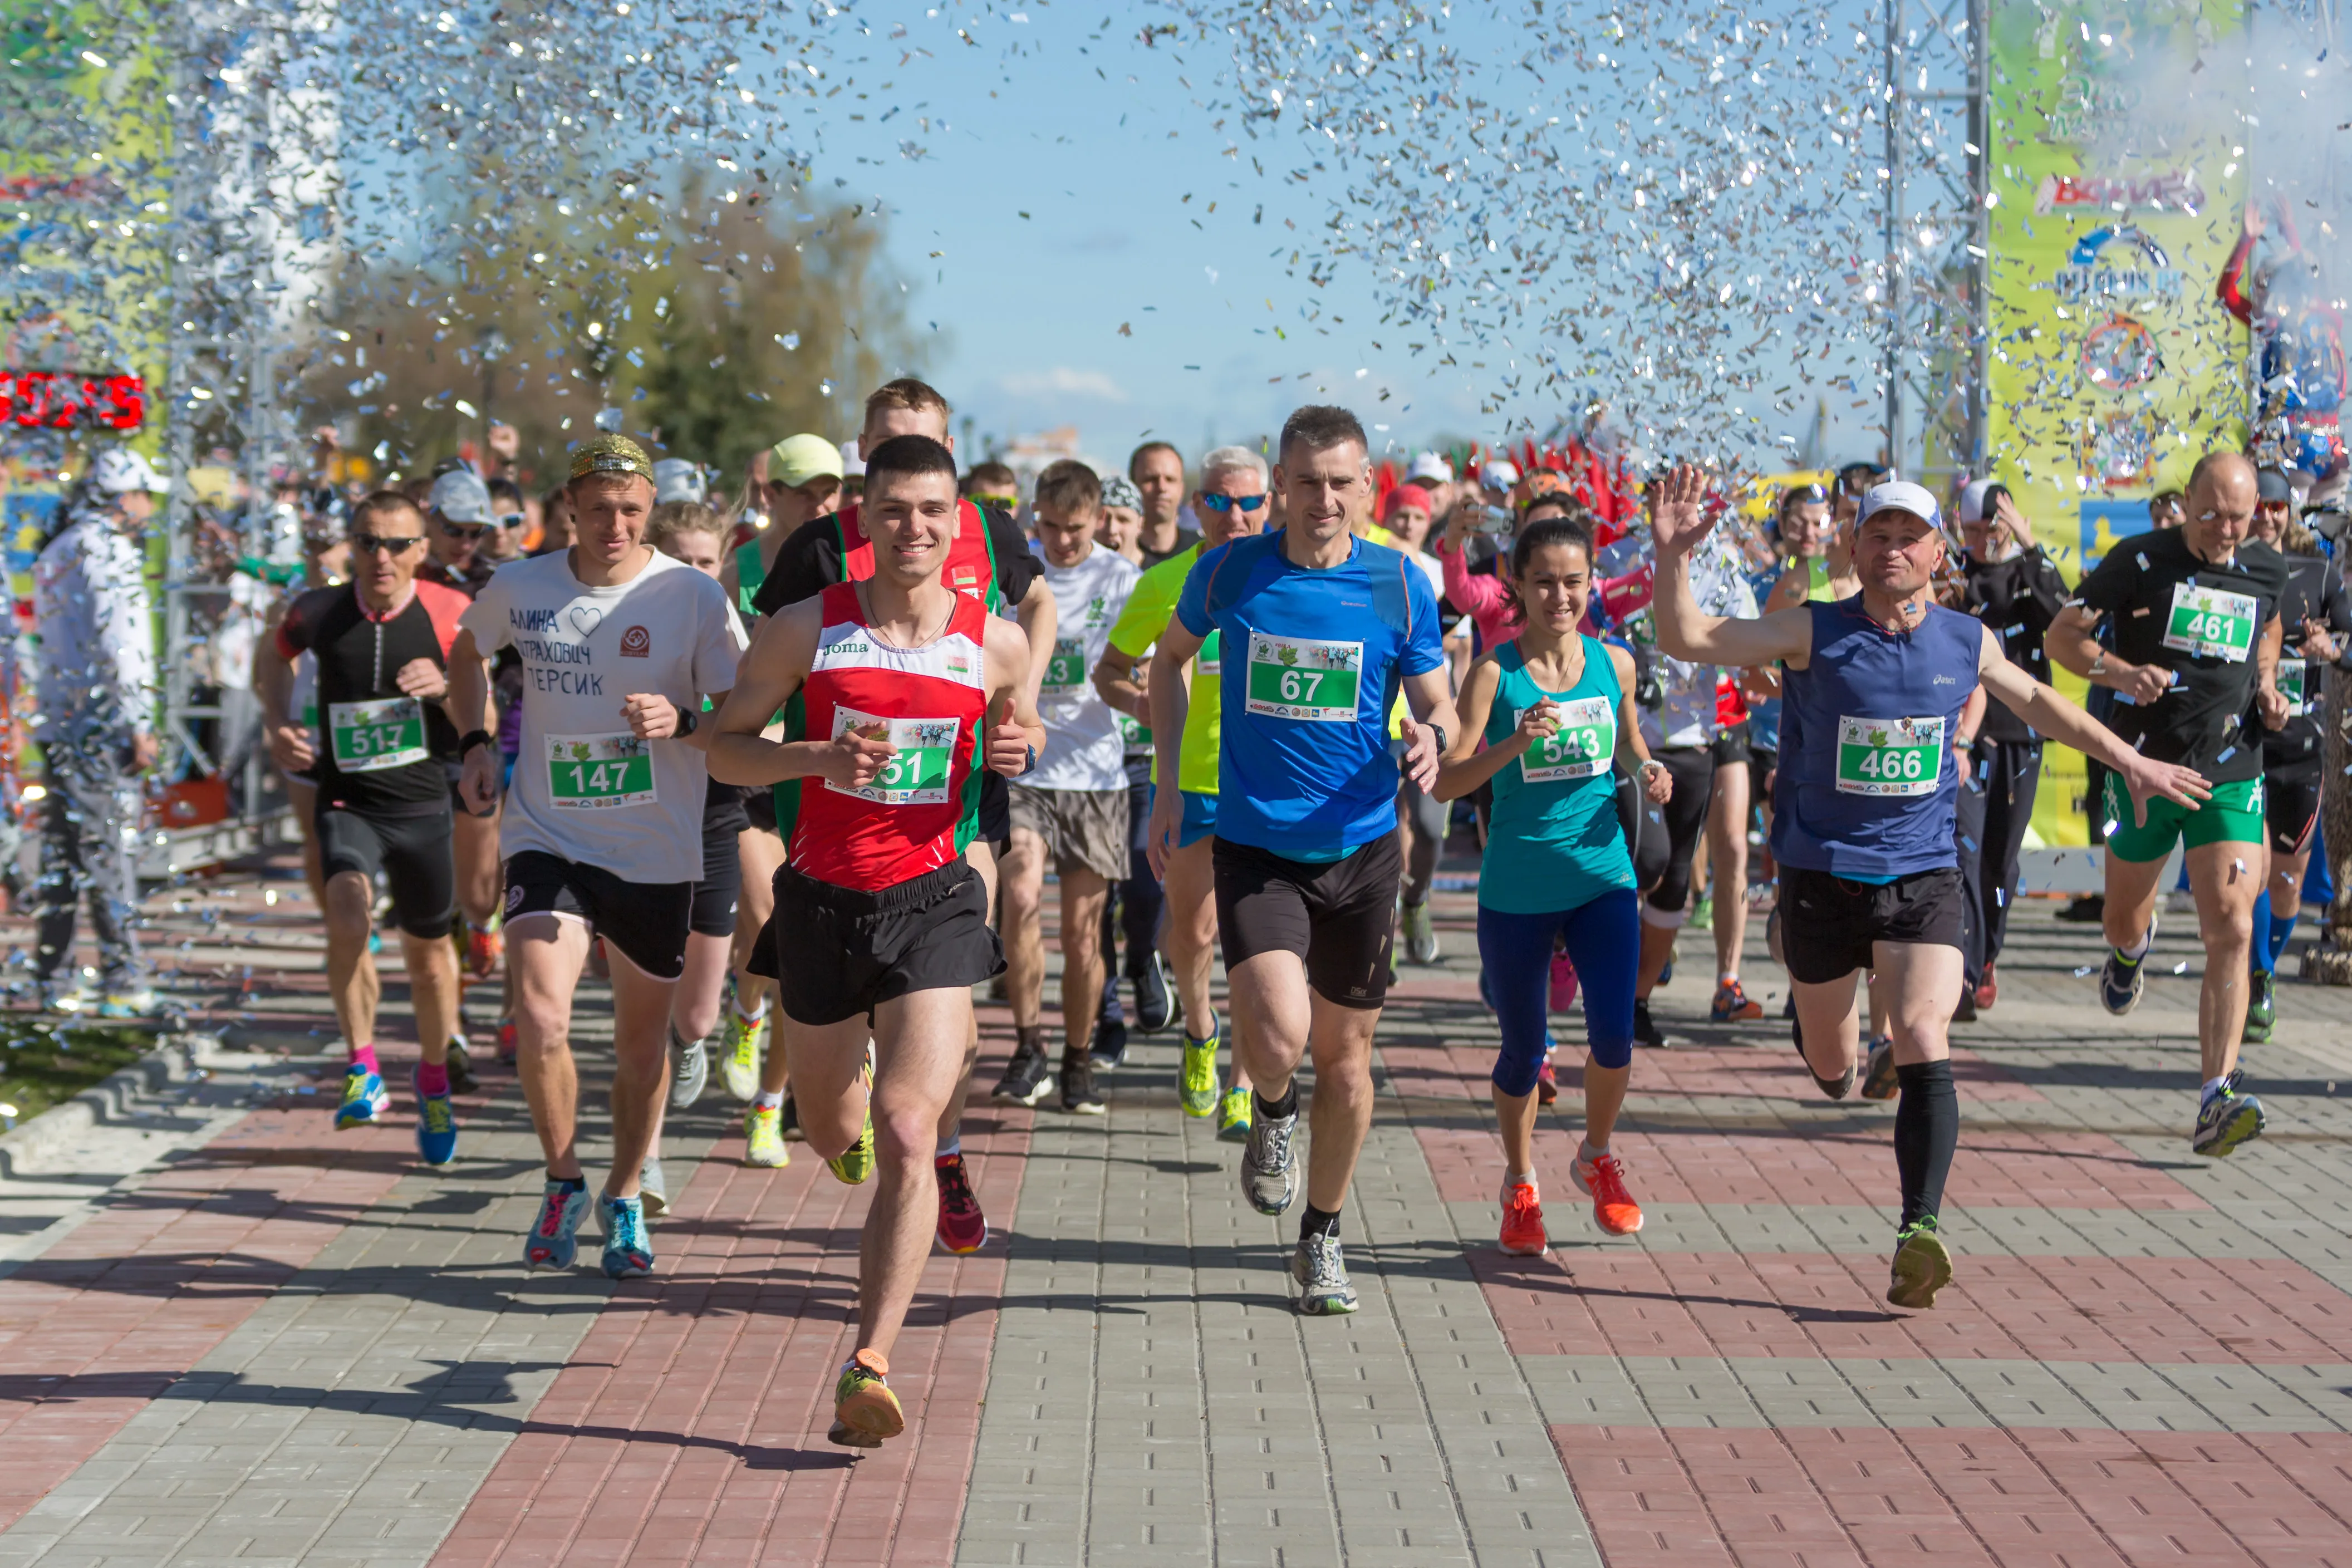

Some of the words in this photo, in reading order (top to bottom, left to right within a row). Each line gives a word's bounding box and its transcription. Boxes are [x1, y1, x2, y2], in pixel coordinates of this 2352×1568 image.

[510, 607, 559, 633] АЛИНА
[2187, 613, 2235, 643] 461
[1280, 670, 1324, 701] 67
[351, 725, 404, 755] 517
[1543, 729, 1600, 763] 543
[569, 762, 628, 793] 147
[880, 751, 922, 785] 51
[1859, 750, 1922, 779] 466
